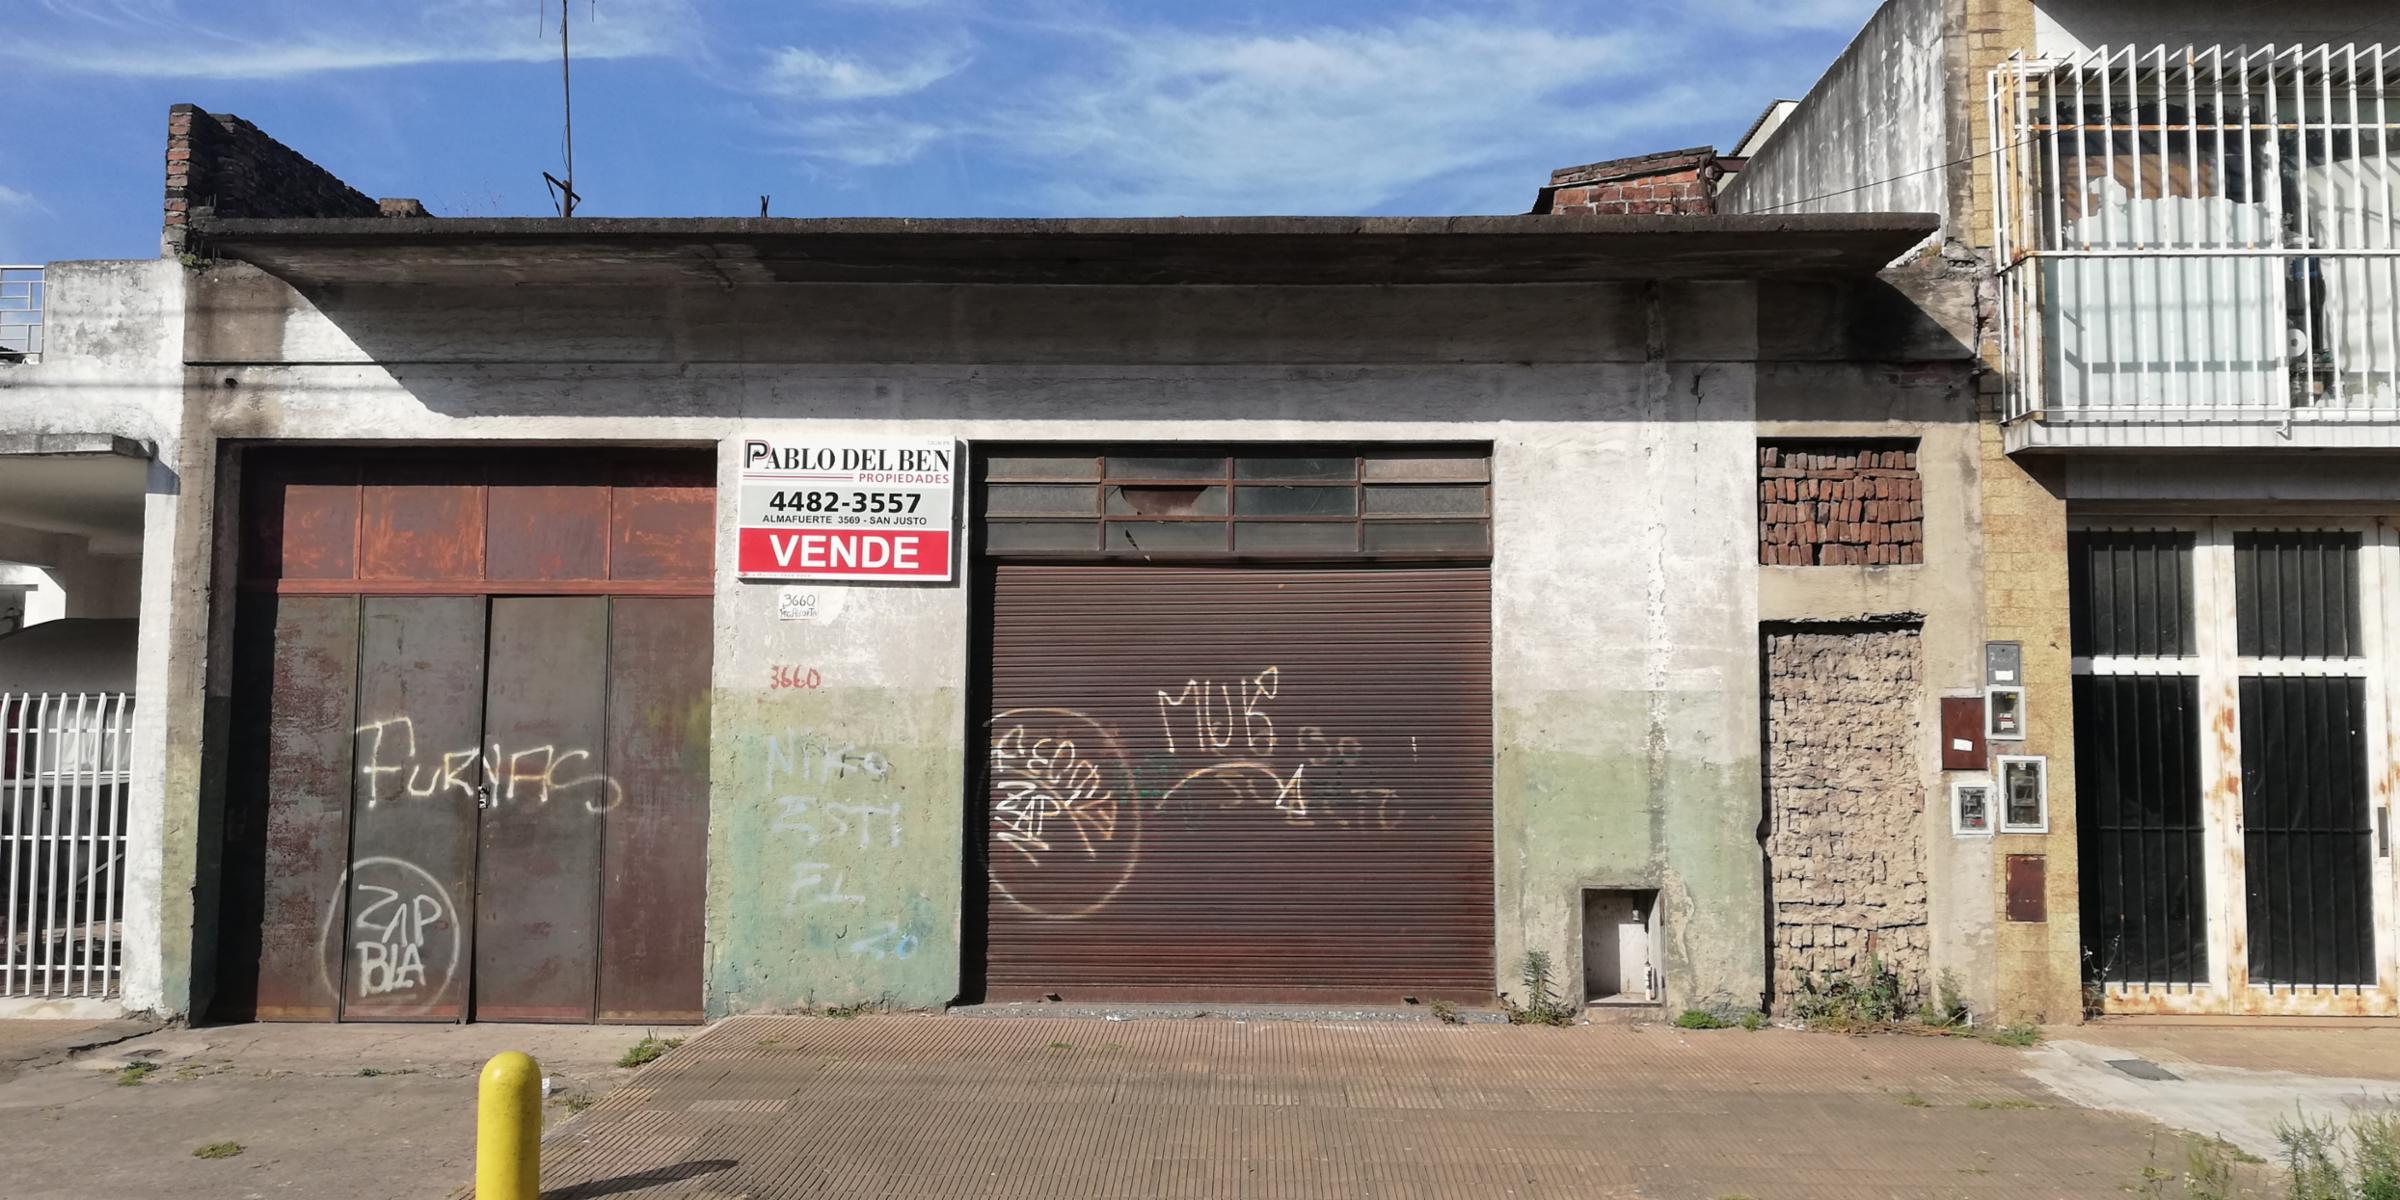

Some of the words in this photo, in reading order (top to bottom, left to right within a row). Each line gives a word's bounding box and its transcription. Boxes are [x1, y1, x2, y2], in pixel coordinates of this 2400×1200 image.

[744, 439, 836, 471] PABLO
[841, 448, 893, 471] DEL
[898, 449, 951, 472] BEN
[858, 472, 950, 484] PROPIEDADES
[769, 491, 922, 514] 4482-3557
[762, 514, 833, 524] ALMAFUERTE
[838, 516, 861, 525] 3569
[869, 517, 891, 525] SAN
[893, 517, 927, 526] JUSTO
[769, 534, 920, 569] VENDE
[770, 664, 821, 690] 3660
